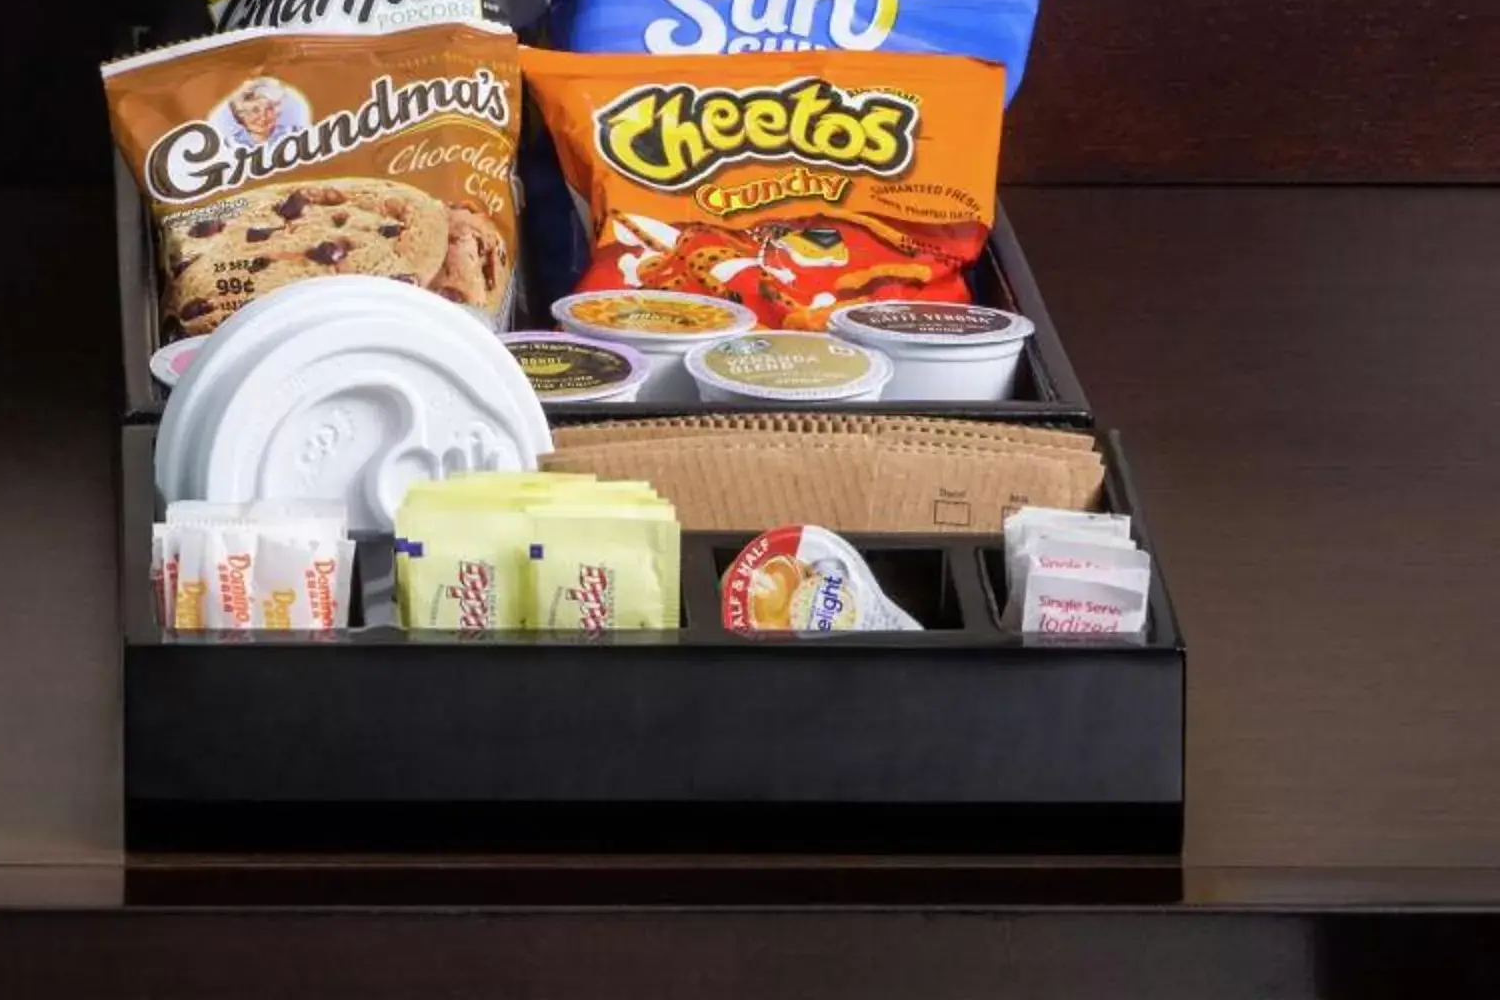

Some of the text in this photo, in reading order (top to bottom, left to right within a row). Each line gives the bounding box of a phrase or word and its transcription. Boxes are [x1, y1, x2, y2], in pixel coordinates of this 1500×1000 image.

[377, 0, 476, 28] POPCORN
[147, 69, 507, 201] Grandma's
[606, 83, 903, 179] Cheetos
[699, 167, 850, 216] Crunchy
[870, 184, 943, 195] GUARANTEED
[215, 277, 255, 296] 99¢
[227, 552, 251, 622] Domino
[815, 573, 844, 632] elight
[1038, 594, 1083, 612] Single
[1040, 613, 1119, 635] Iodized
